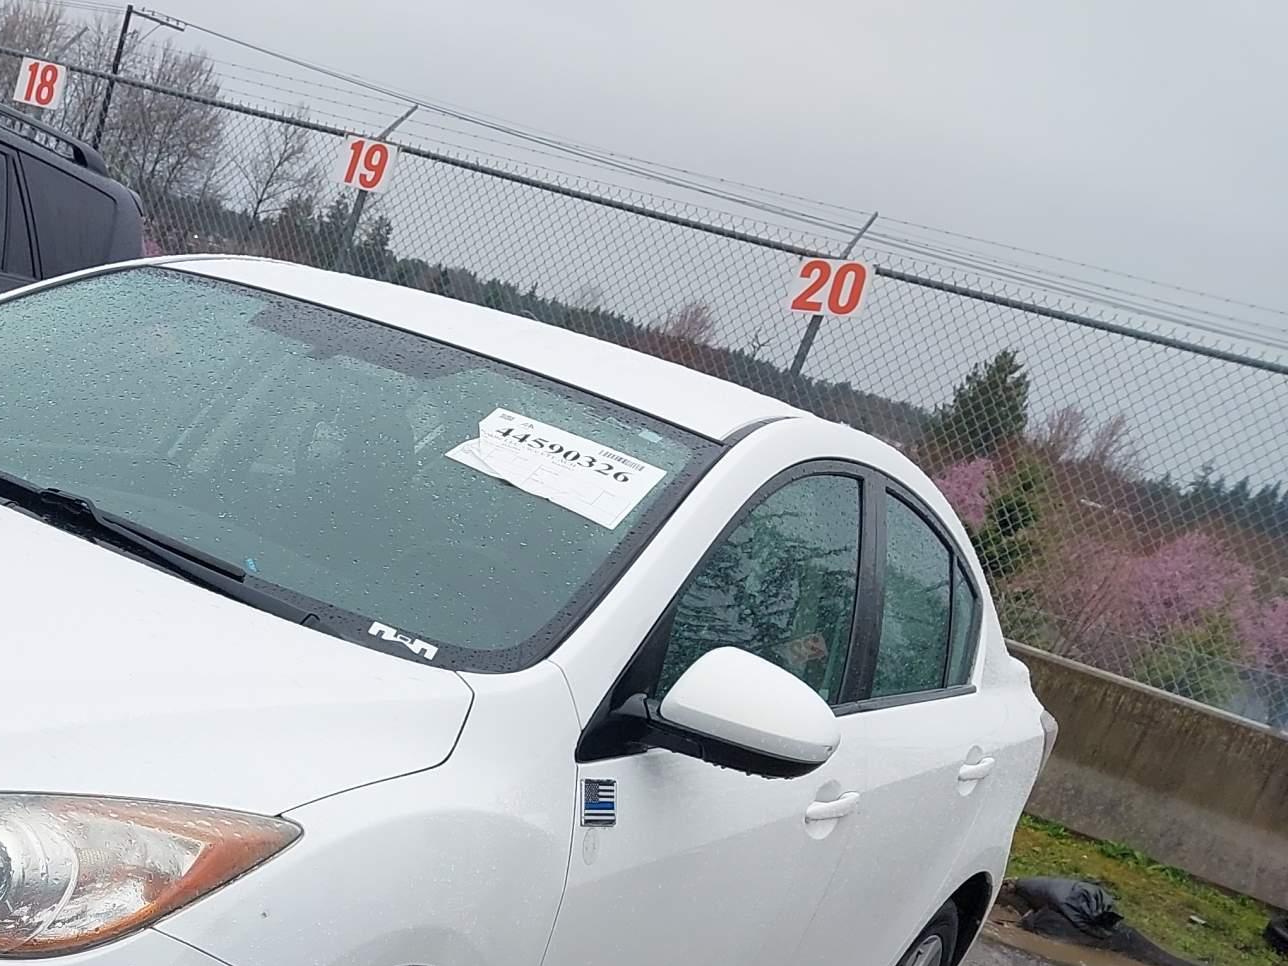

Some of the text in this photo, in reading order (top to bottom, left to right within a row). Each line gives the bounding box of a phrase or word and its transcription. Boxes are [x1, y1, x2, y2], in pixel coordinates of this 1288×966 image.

[24, 61, 58, 106] 18
[344, 139, 389, 189] 19
[791, 259, 867, 315] 20
[495, 426, 634, 484] 44590326
